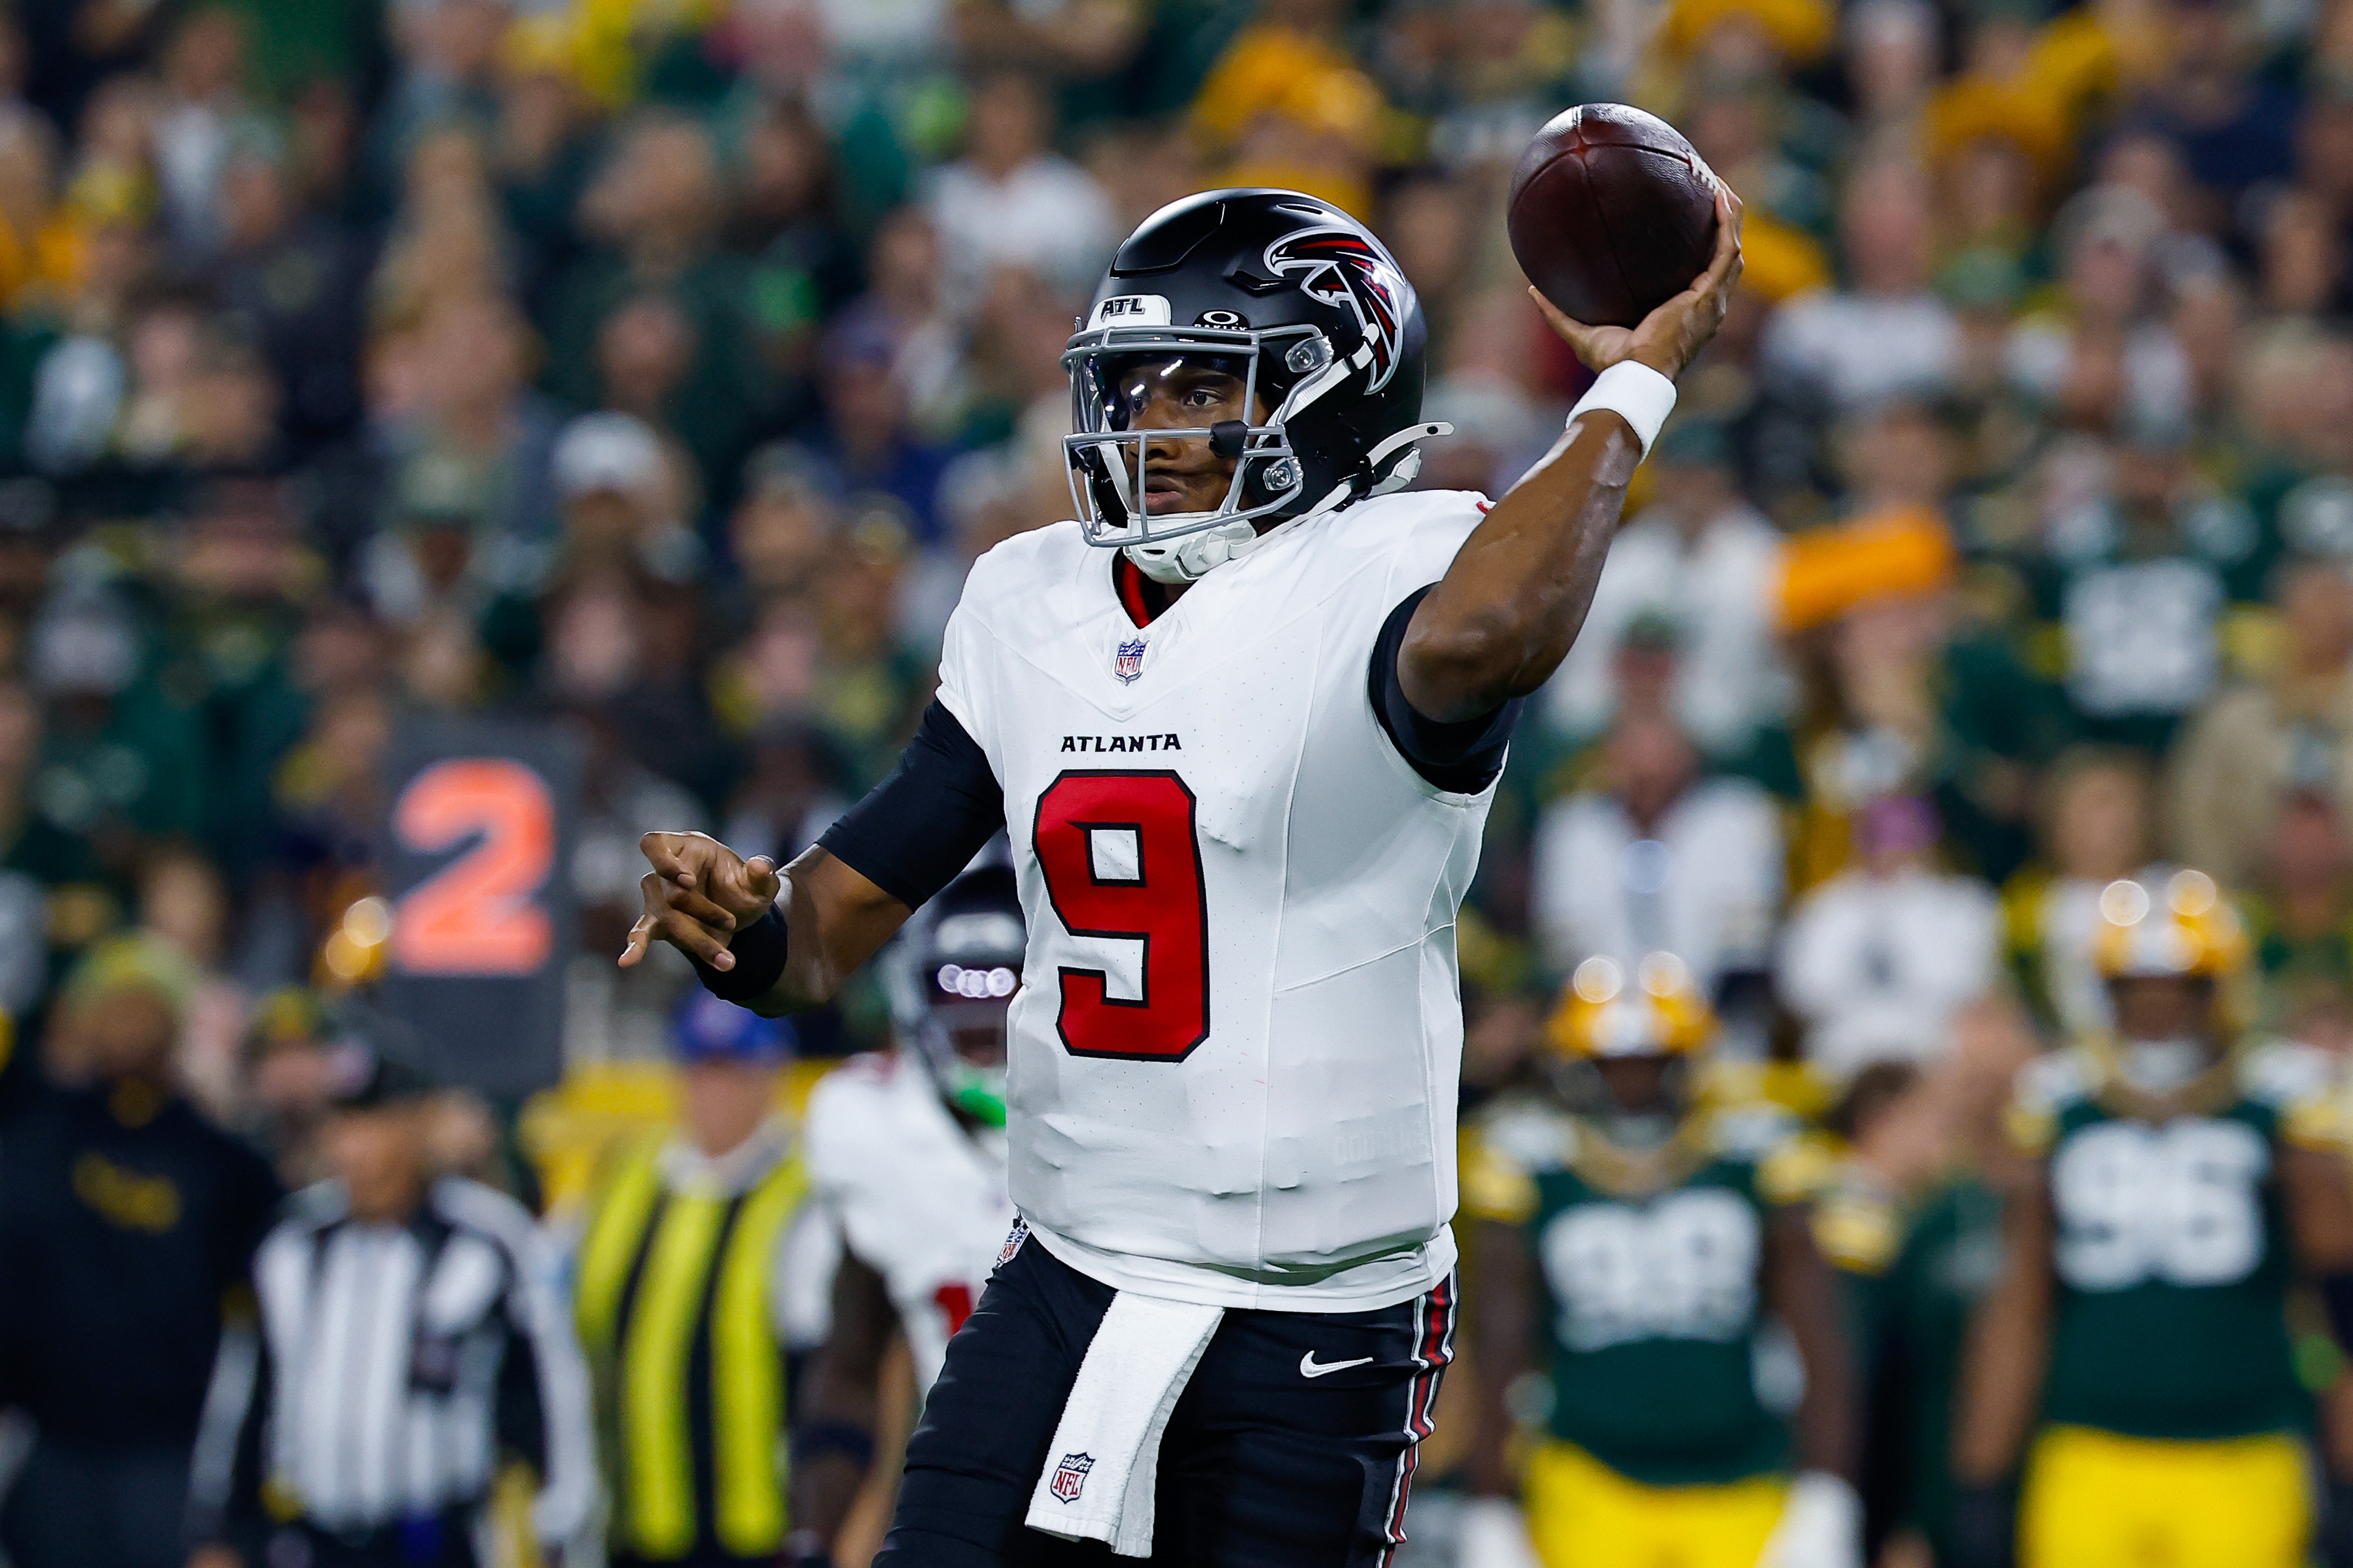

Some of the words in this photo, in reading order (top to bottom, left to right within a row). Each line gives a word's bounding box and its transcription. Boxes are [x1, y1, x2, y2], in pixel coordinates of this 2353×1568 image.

[1101, 298, 1145, 322] ATL
[1117, 657, 1138, 675] NFL
[1061, 734, 1182, 752] ATLANTA
[391, 758, 555, 977] 2
[1031, 769, 1210, 1063] 9
[2052, 1118, 2270, 1291] 96
[1053, 1471, 1080, 1496] NFL
